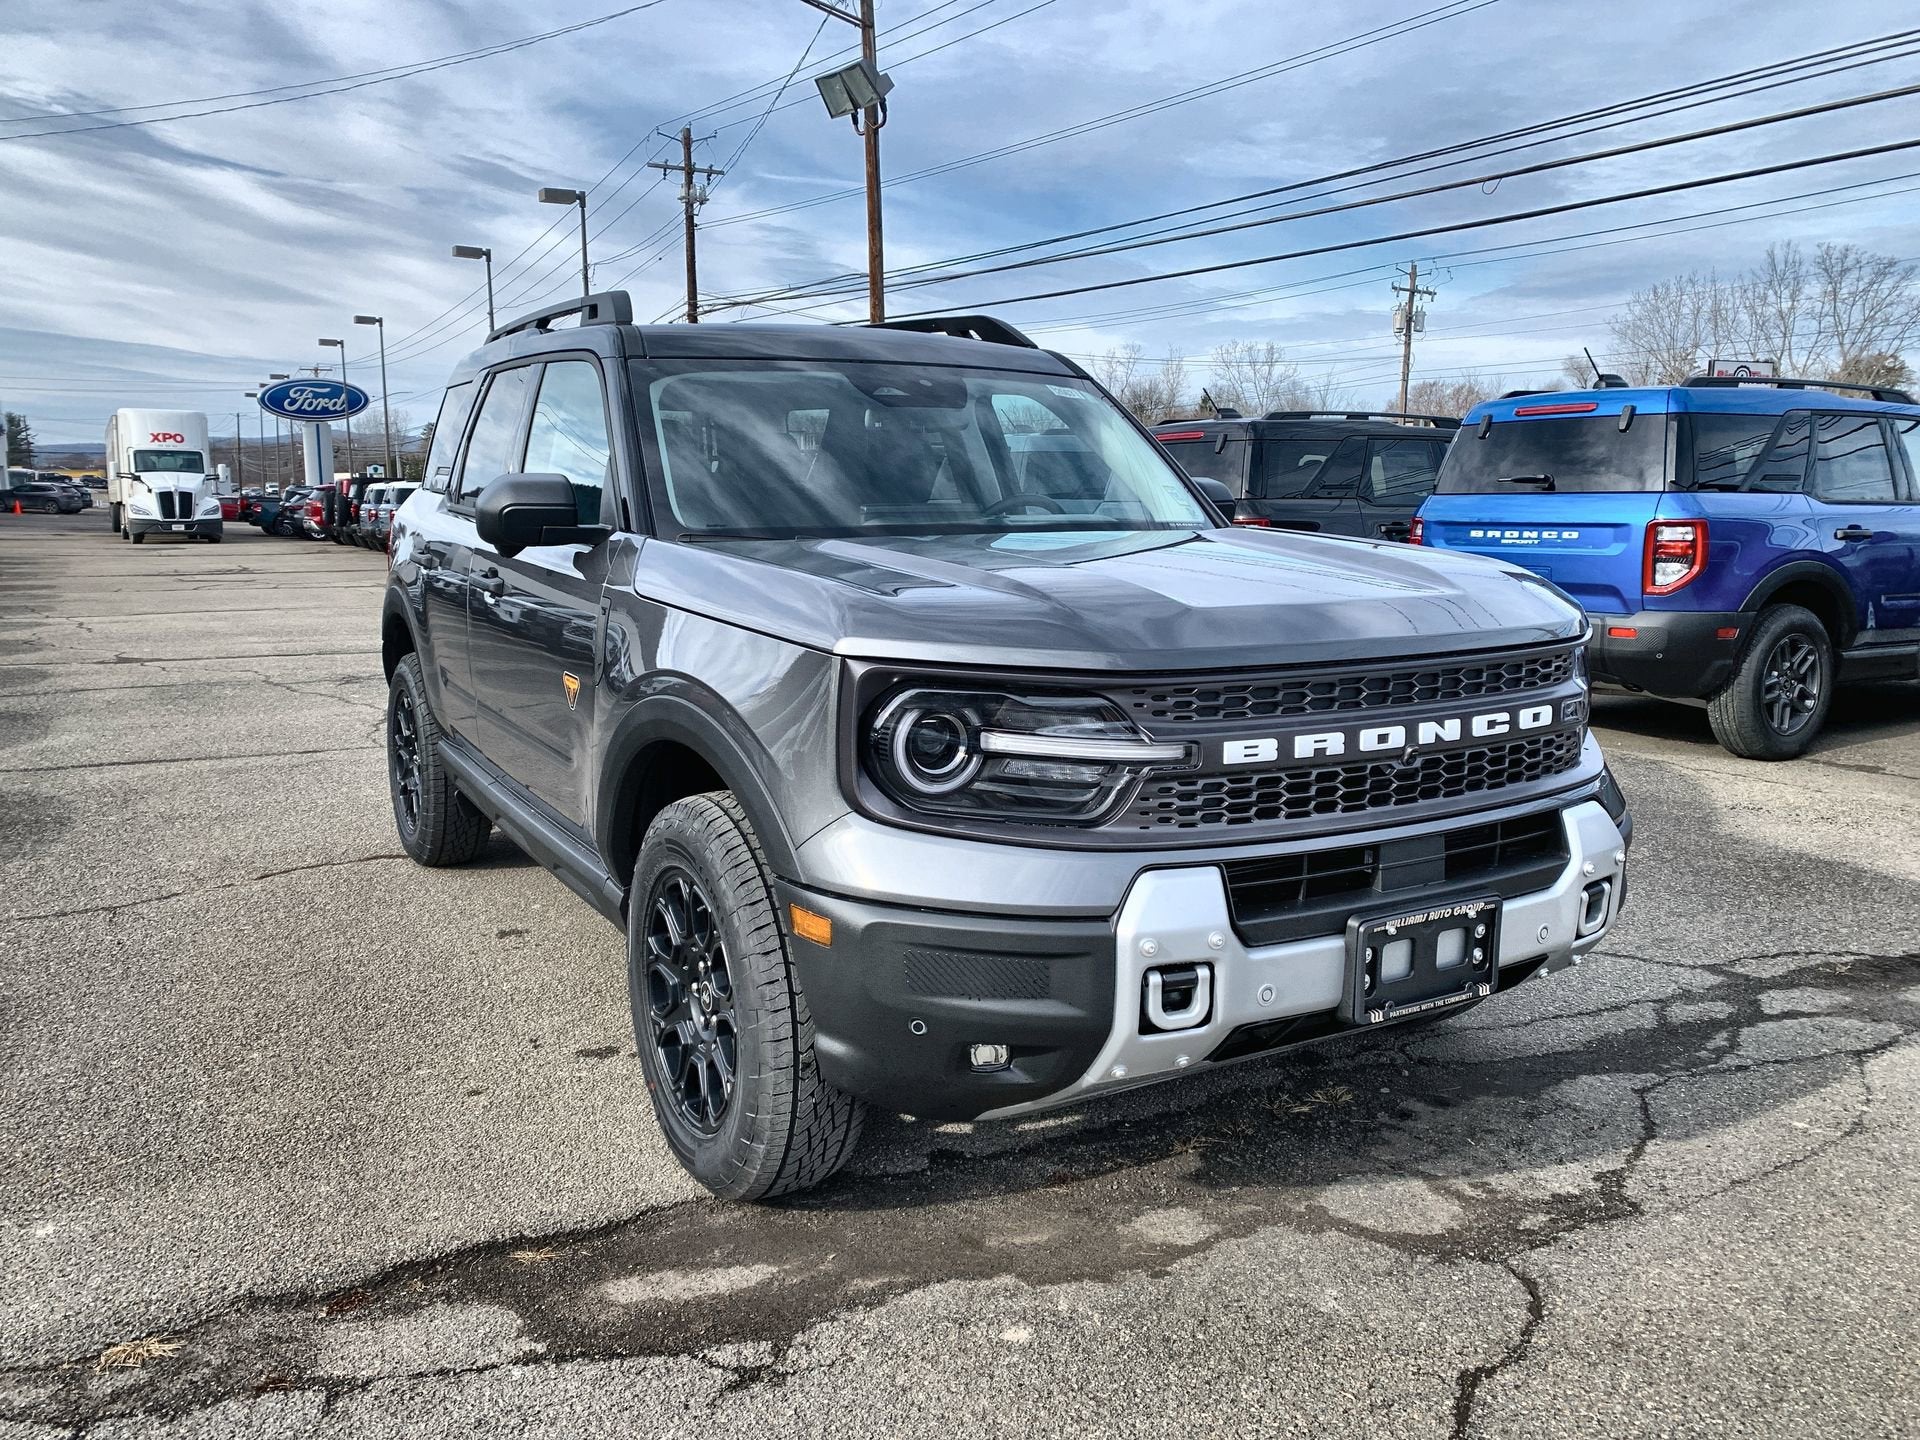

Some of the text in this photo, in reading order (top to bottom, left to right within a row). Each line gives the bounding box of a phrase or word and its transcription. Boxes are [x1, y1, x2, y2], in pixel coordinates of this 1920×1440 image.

[283, 386, 347, 411] Ford
[149, 432, 185, 444] XPO
[1470, 530, 1579, 539] BRONCO
[1223, 704, 1553, 765] BRONCO
[1428, 908, 1452, 921] AUTO
[1389, 1005, 1420, 1018] PARTNERING
[1421, 1003, 1435, 1011] WITH
[1445, 993, 1473, 1004] COMMUNITY
